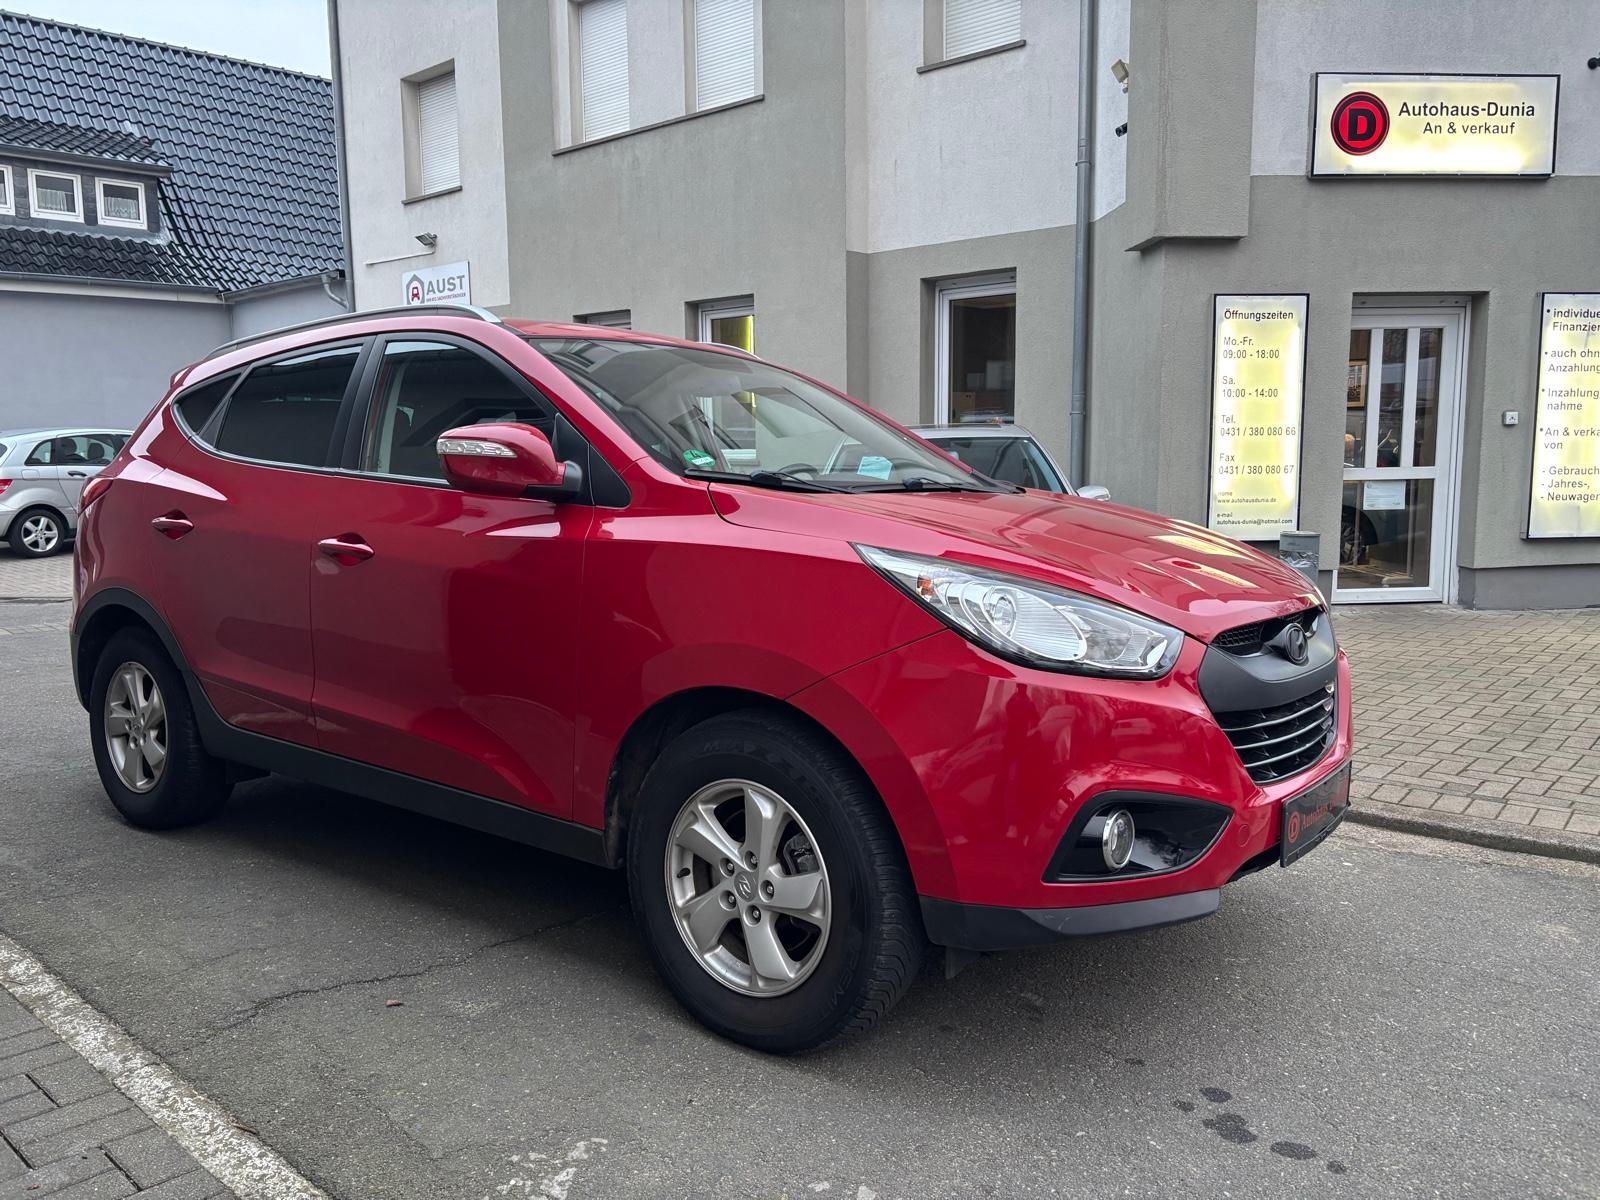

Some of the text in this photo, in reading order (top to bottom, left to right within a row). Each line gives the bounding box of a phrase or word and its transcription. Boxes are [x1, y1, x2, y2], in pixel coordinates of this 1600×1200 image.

[1398, 101, 1535, 117] Autohaus-Dunia
[1423, 122, 1516, 135] An & verkauf
[426, 275, 465, 295] AUST
[1224, 308, 1294, 322] Öffnungszeiten
[1223, 336, 1254, 346] Mo.-Fr.
[1222, 349, 1247, 359] 09:00
[1256, 349, 1280, 359] 18:00
[1550, 348, 1577, 358] auch
[1222, 375, 1236, 385] Sa.
[1222, 388, 1246, 398] 10:00
[1255, 388, 1279, 398] 14:00
[1547, 401, 1583, 411] nahme
[1221, 414, 1236, 424] Tel.
[1220, 427, 1240, 437] 0431
[1249, 427, 1265, 436] 380
[1267, 427, 1283, 436] 080
[1285, 426, 1296, 436] 66
[1544, 427, 1559, 437] An
[1562, 427, 1570, 437] &
[1544, 442, 1563, 450] von
[1219, 453, 1235, 462] Fax
[1218, 465, 1239, 475] 0431
[1247, 465, 1263, 475] 380
[1265, 465, 1281, 474] 080
[1283, 464, 1295, 474] 67
[1548, 466, 1600, 476] Gebrauch
